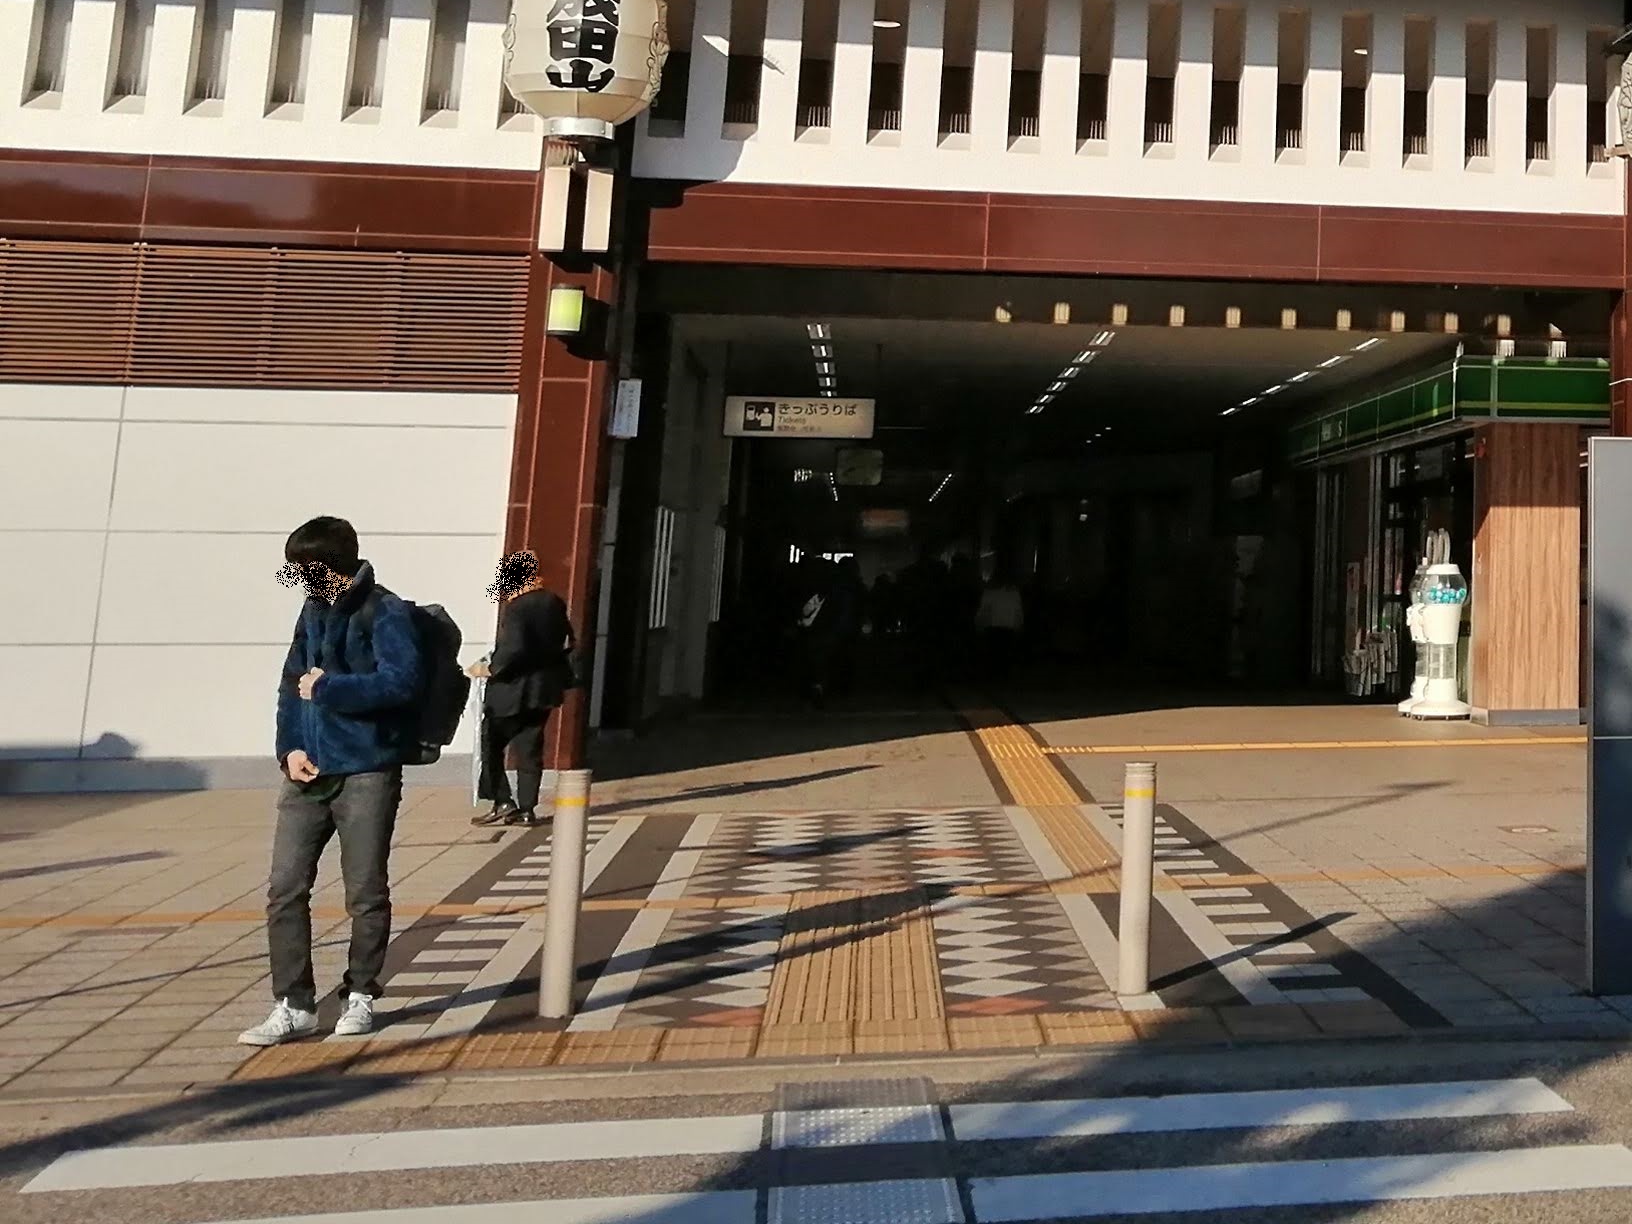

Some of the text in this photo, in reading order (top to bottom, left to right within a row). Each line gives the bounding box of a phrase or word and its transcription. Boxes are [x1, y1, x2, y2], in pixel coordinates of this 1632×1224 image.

[778, 403, 858, 416] きっぷうりば
